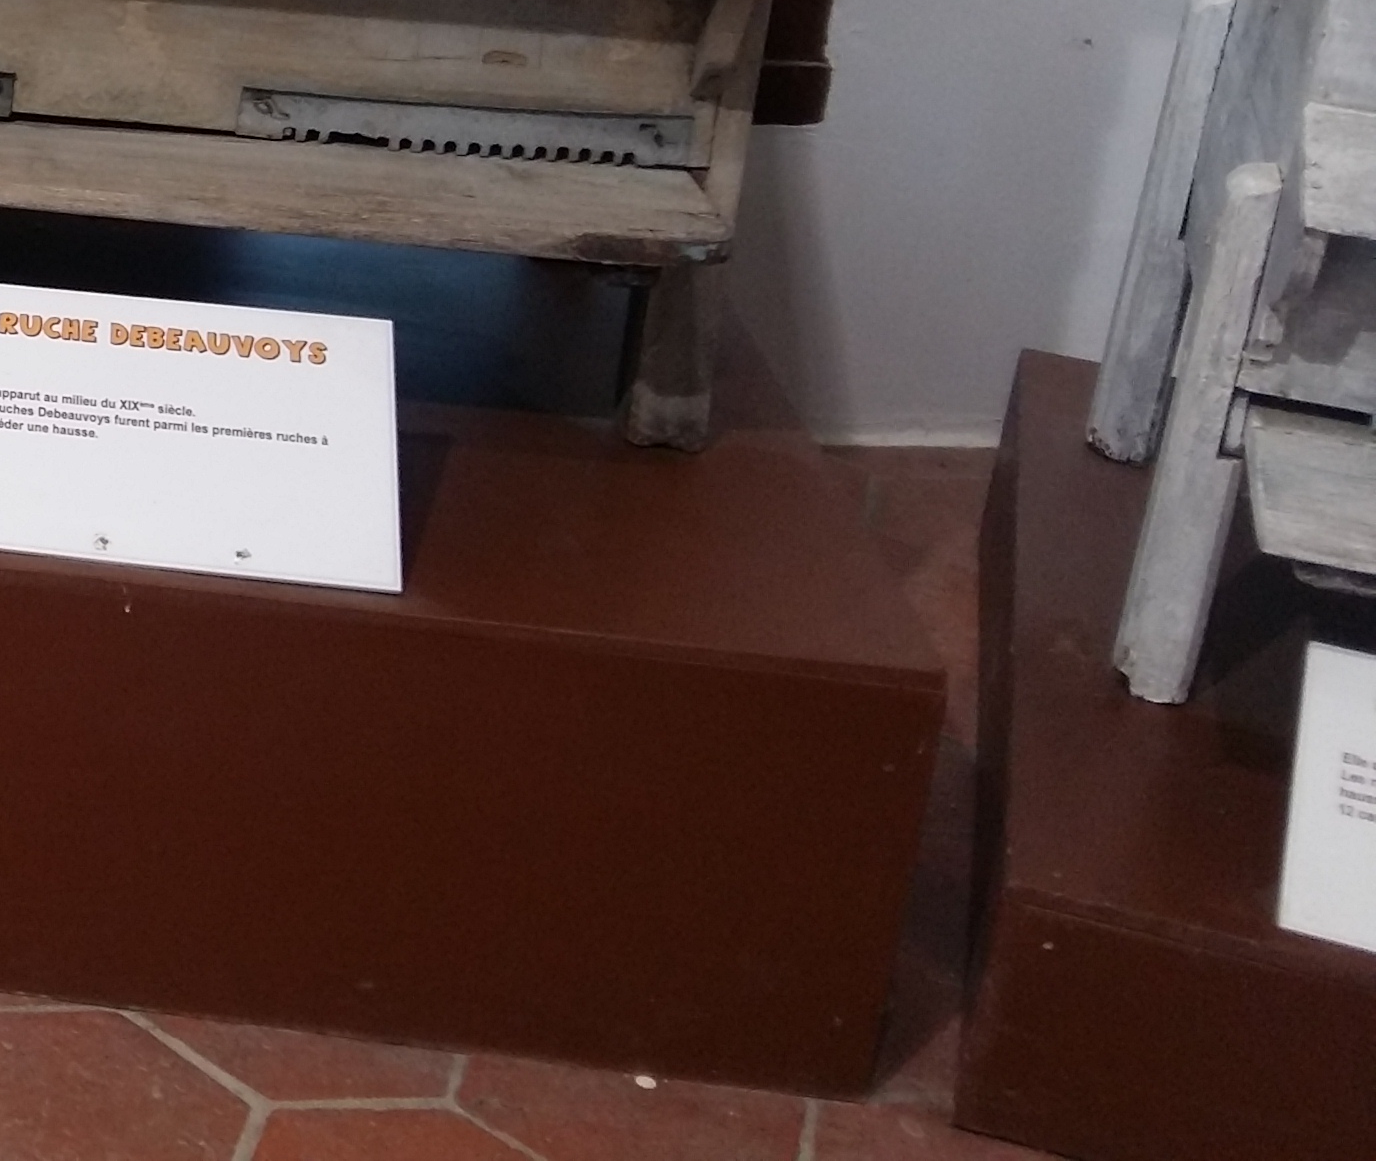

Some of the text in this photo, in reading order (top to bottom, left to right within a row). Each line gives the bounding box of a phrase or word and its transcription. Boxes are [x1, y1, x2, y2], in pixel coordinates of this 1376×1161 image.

[110, 323, 329, 366] DEBEAUVOYS
[43, 393, 59, 404] au
[61, 395, 97, 408] milieu
[101, 398, 116, 410] du
[158, 404, 196, 418] siècle.
[27, 422, 50, 434] une
[52, 423, 99, 439] hausse.
[38, 407, 110, 426] Debeauvoys
[114, 414, 150, 429] furent
[153, 418, 188, 432] parmi
[191, 422, 209, 435] les
[212, 426, 273, 441] premières
[276, 432, 318, 446] ruches
